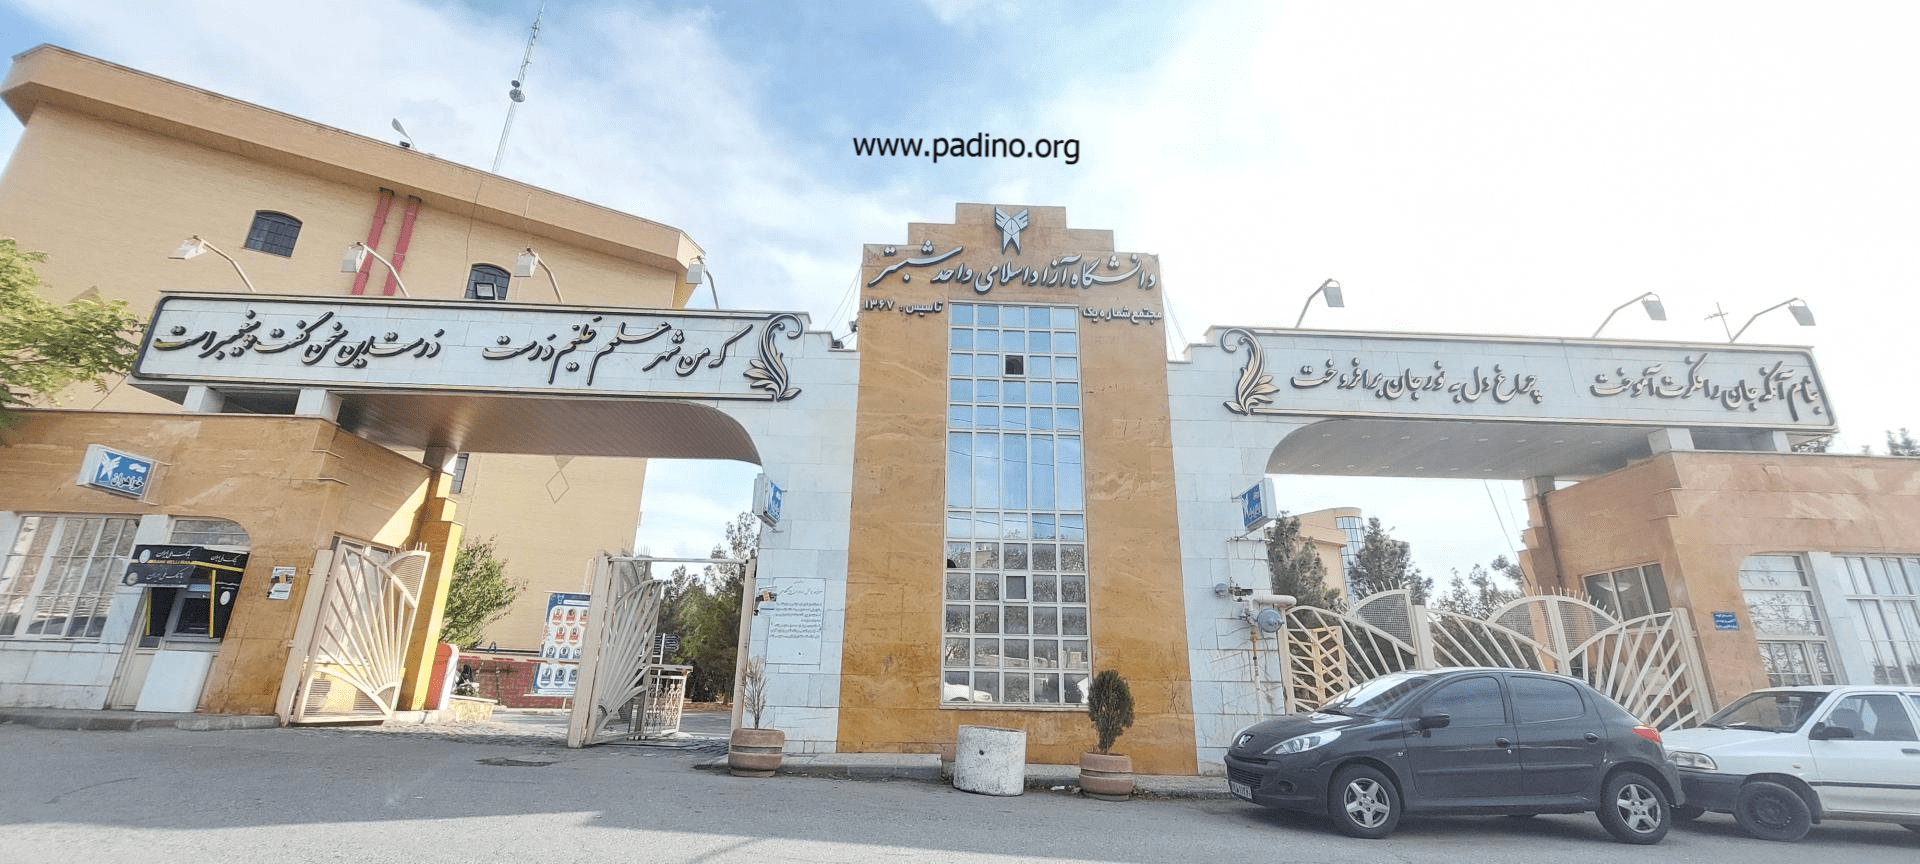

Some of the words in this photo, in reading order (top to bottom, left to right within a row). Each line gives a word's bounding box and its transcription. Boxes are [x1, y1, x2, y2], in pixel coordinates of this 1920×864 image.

[867, 239, 964, 288] شبستر
[930, 263, 974, 285] واحد
[1028, 251, 1082, 288] آزاد
[1070, 252, 1157, 290] دانشگاه
[974, 261, 1029, 295] اسلامی
[864, 298, 895, 312] ۱۳۶۷
[1082, 306, 1100, 324] یک
[1100, 305, 1131, 322] شماره
[1131, 307, 1162, 326] مجتمع
[675, 347, 711, 377] من
